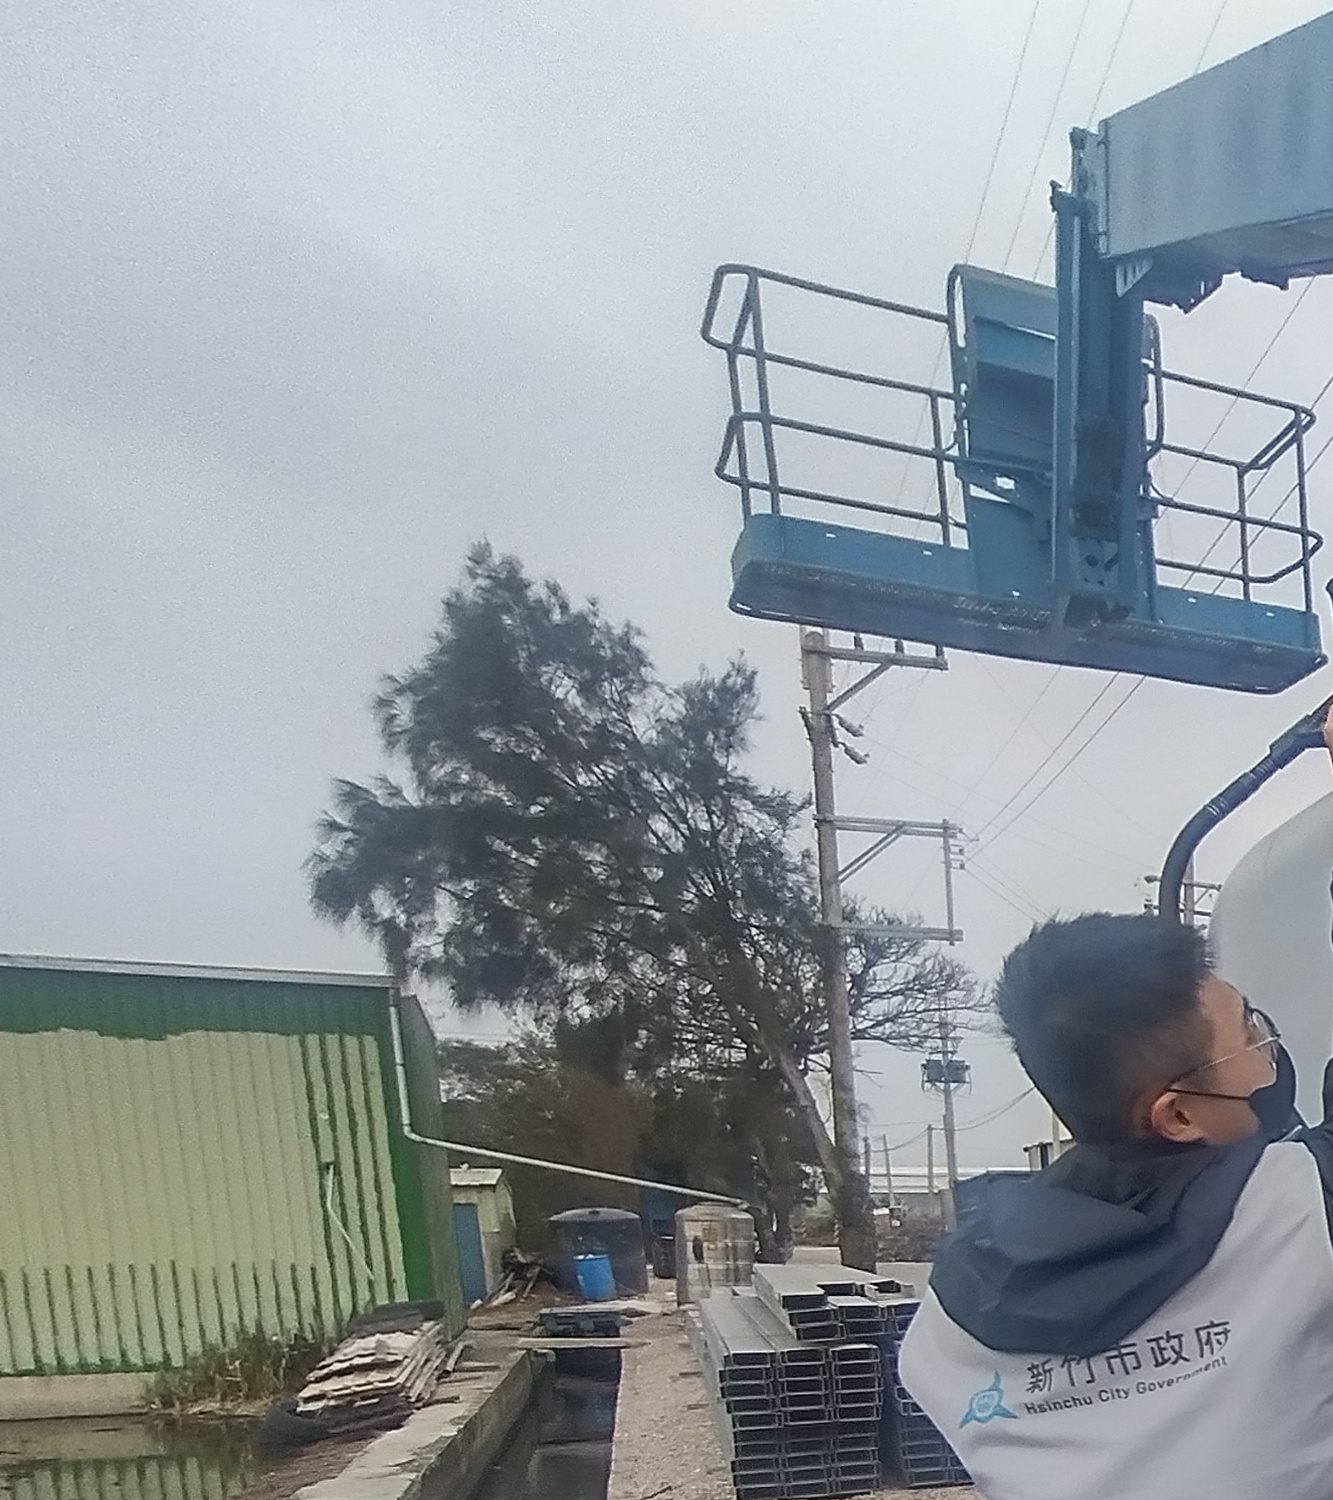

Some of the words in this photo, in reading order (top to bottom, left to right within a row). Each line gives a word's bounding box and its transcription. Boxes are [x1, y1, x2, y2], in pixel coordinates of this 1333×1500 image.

[1024, 1393, 1093, 1415] Hsinchu
[1098, 1383, 1131, 1403] City
[1136, 1355, 1228, 1395] Government
[1025, 1319, 1232, 1394] 新竹市政府
